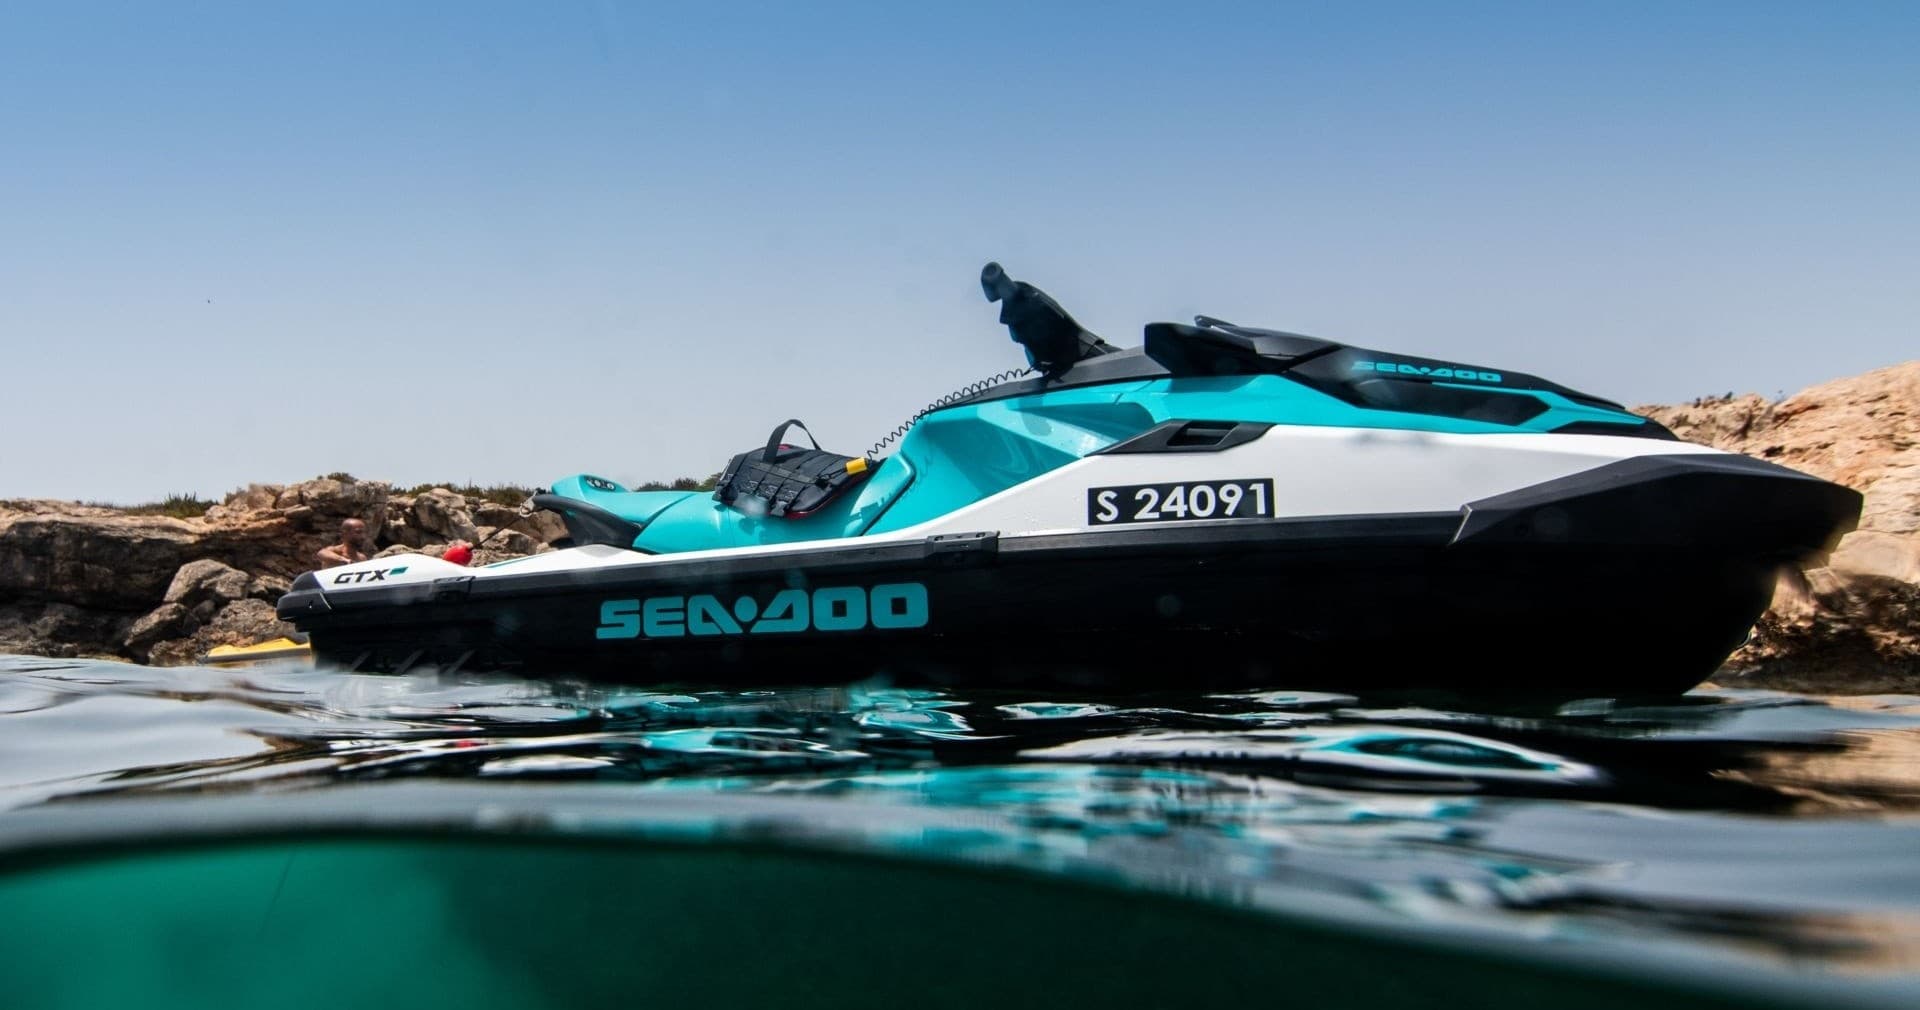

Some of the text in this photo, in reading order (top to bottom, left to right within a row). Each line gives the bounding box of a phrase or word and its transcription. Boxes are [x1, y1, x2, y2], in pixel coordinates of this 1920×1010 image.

[1096, 483, 1266, 522] S 24091
[334, 568, 389, 584] GTX
